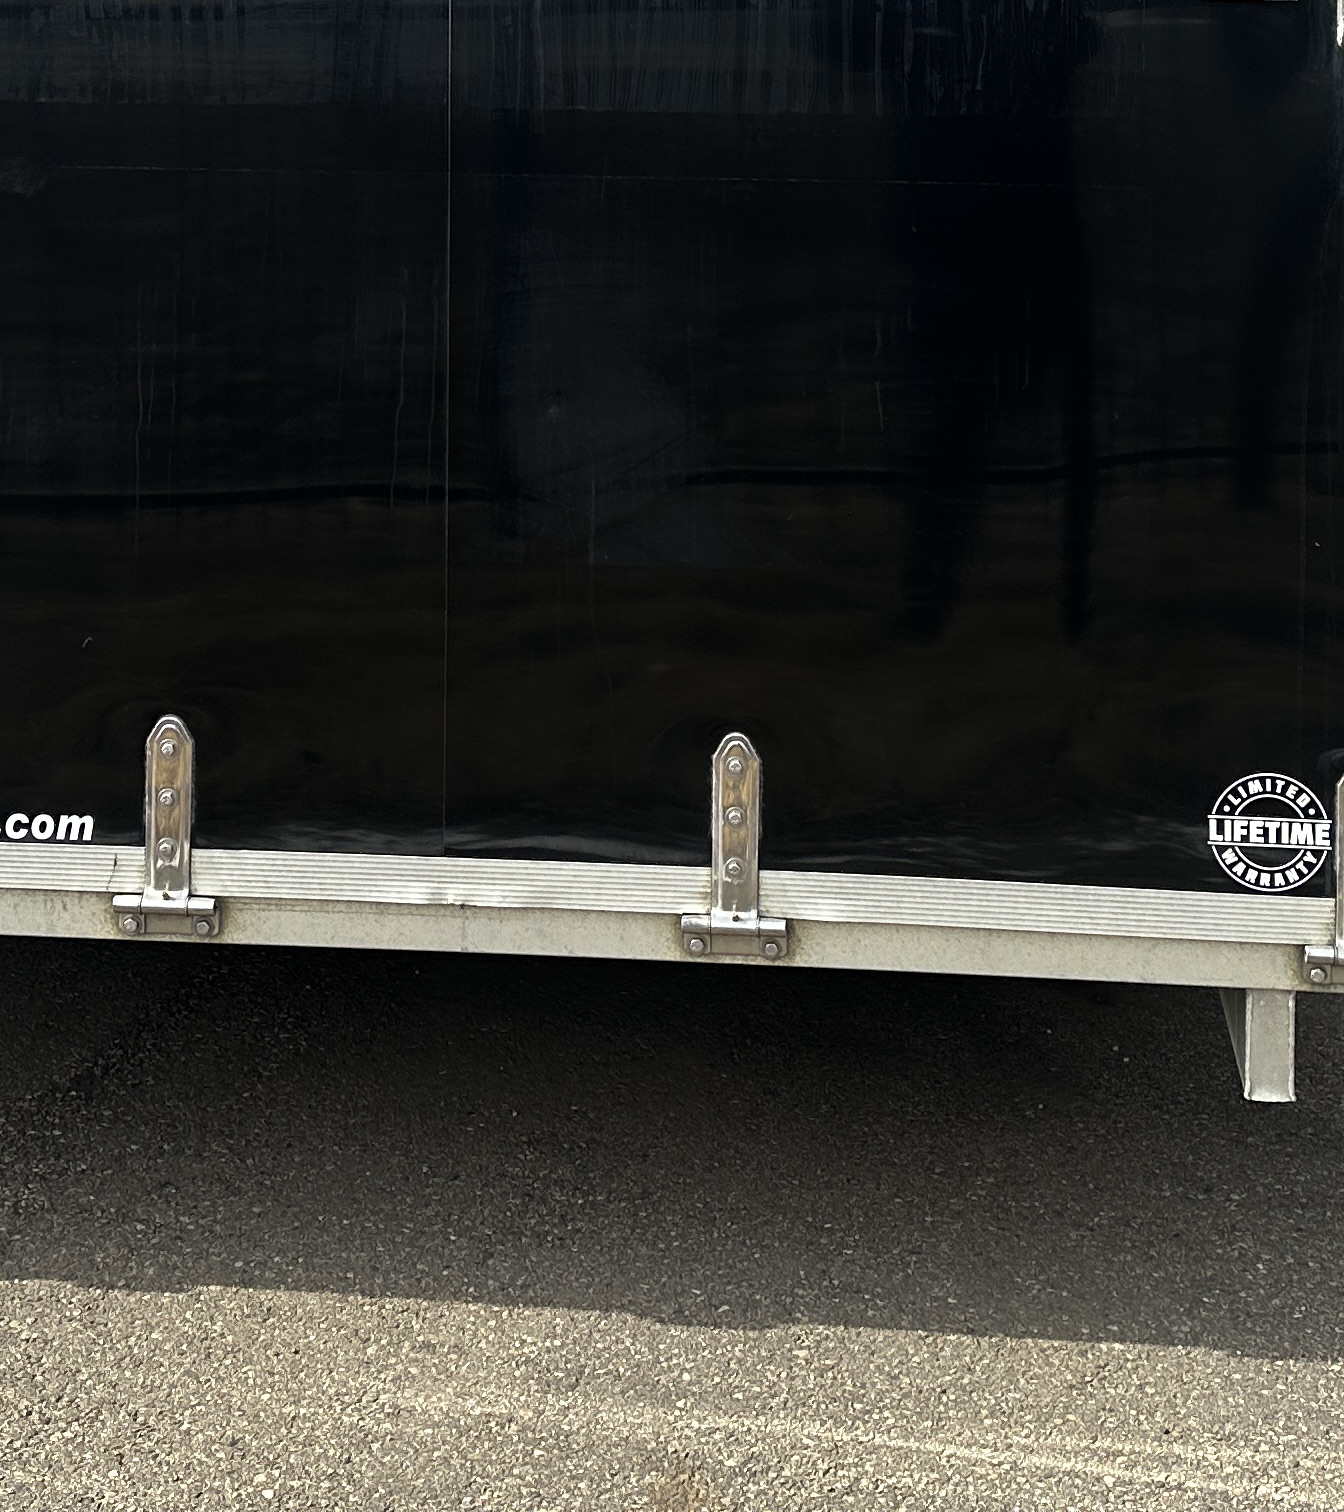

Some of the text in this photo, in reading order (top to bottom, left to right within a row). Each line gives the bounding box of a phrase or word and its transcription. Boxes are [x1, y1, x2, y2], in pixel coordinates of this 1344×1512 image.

[1227, 778, 1311, 808] LIMITED
[1208, 818, 1331, 847] LIFETIME
[1221, 848, 1318, 887] WARRANTY
